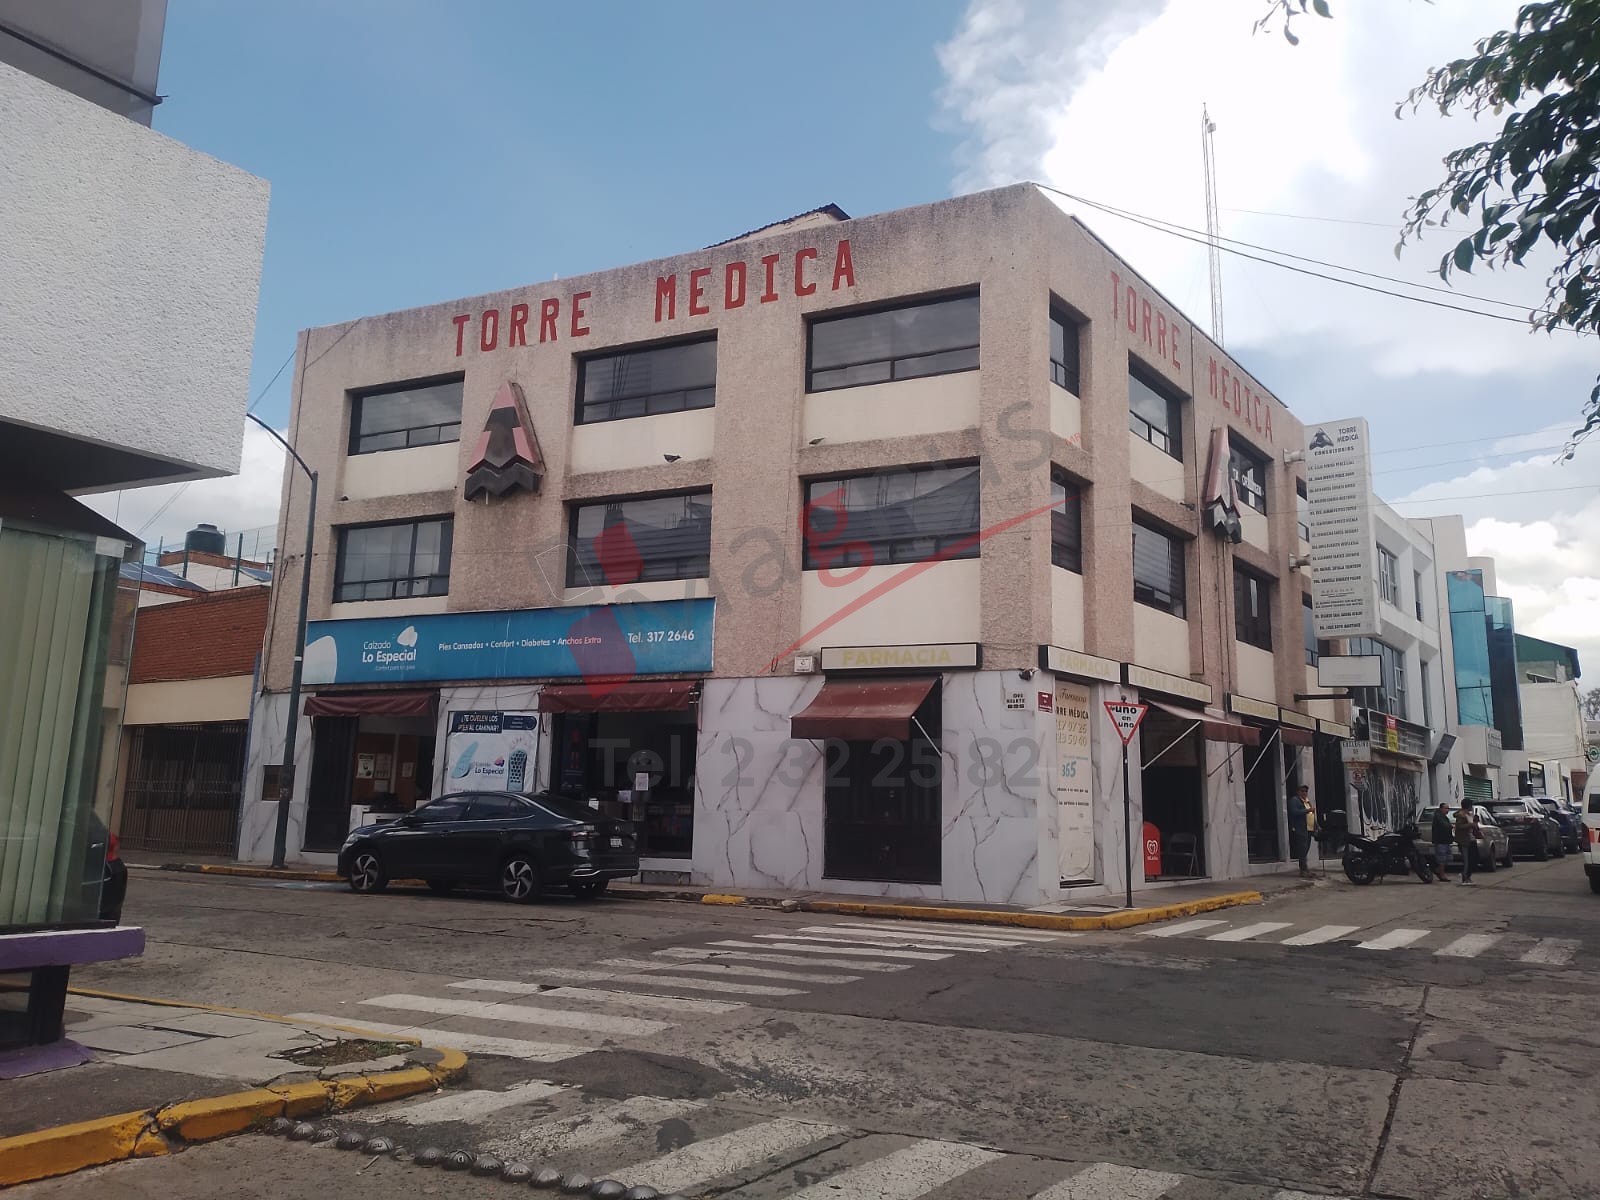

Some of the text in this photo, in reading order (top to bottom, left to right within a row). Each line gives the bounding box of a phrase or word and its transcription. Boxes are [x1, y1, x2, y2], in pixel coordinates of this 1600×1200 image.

[453, 239, 856, 357] TORRE MEDICA
[1110, 270, 1273, 442] TORRE MEDICA
[1338, 426, 1357, 434] TORRE
[1337, 434, 1359, 443] MEDICA
[438, 636, 602, 651] Pies Cansados Confort Diabetes Anchos Extra
[628, 629, 695, 644] Tel. 317 2646
[363, 640, 391, 650] Calzado
[362, 649, 417, 665] Lo Especial
[841, 647, 952, 666] FARMACIA
[1059, 652, 1111, 677] FARMACIA
[1115, 705, 1137, 714] uno
[482, 767, 504, 776] Especial
[1061, 760, 1077, 778] 365
